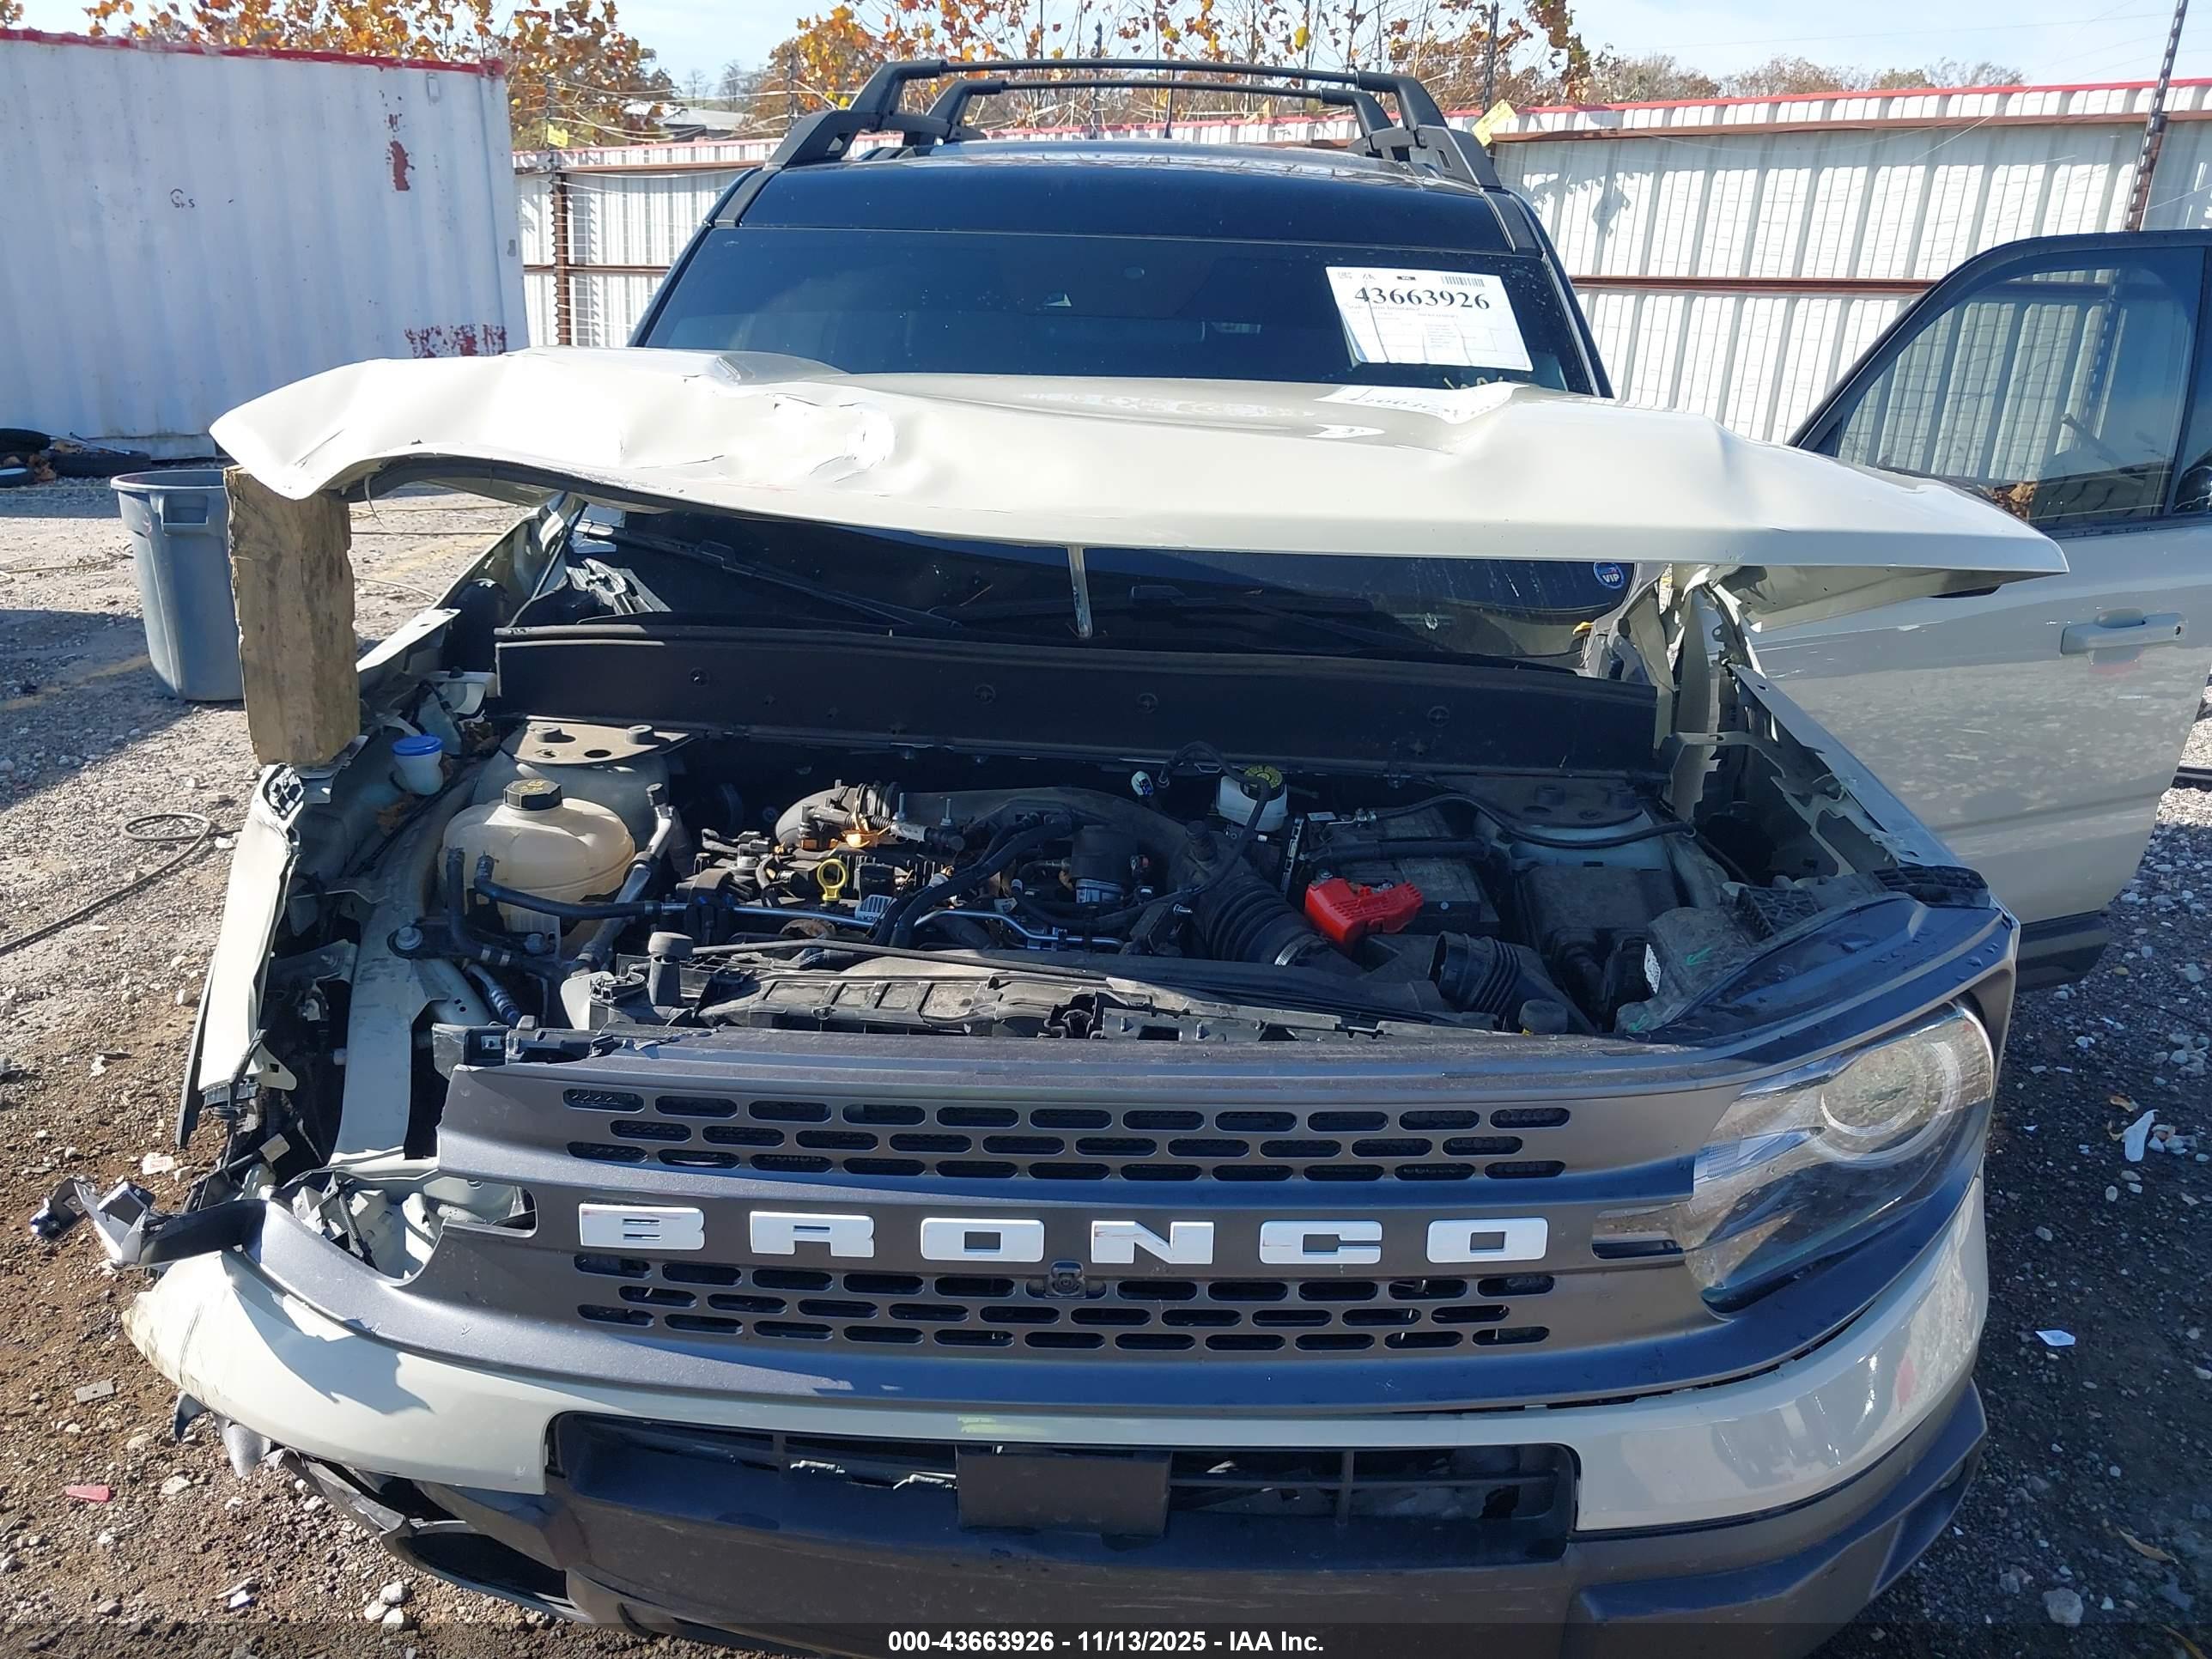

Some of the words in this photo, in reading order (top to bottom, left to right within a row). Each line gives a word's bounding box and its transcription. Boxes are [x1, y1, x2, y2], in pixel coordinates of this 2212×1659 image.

[1355, 287, 1490, 310] 43663926
[1601, 573, 1620, 584] VIP
[577, 1201, 1549, 1266] BRONCO
